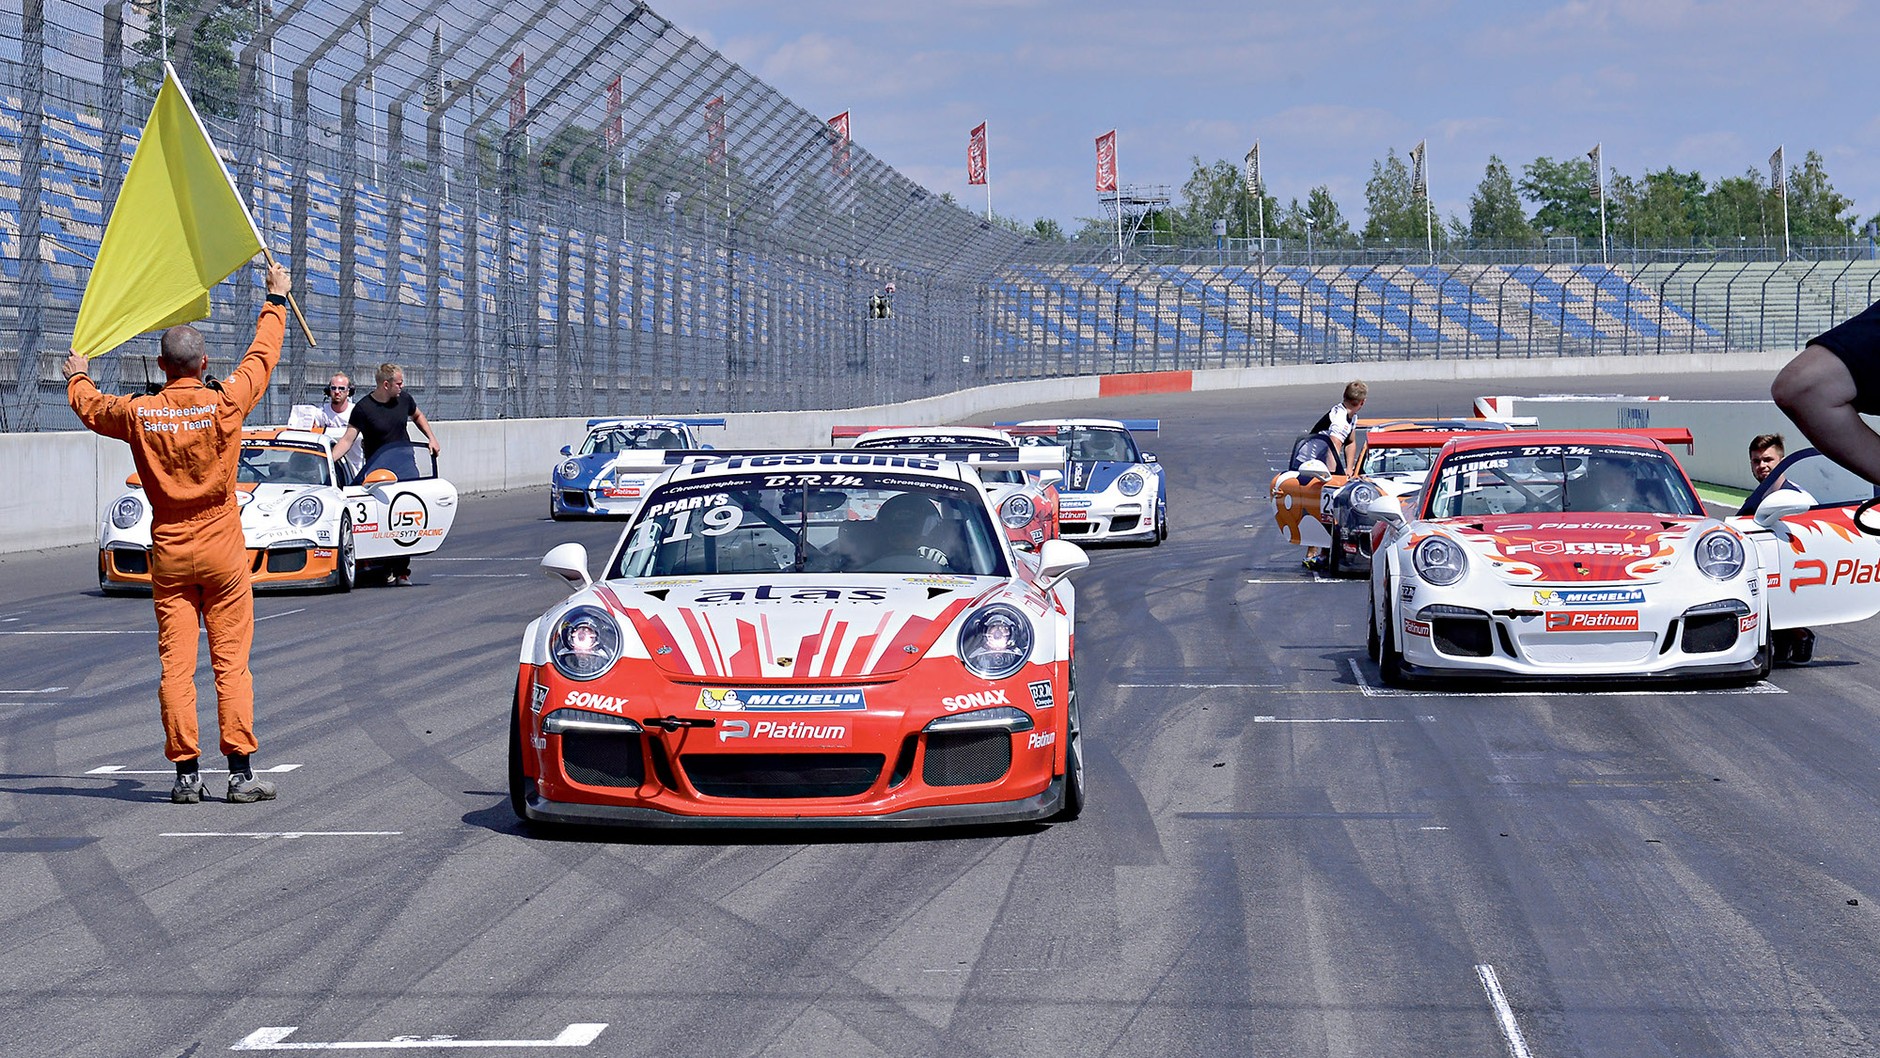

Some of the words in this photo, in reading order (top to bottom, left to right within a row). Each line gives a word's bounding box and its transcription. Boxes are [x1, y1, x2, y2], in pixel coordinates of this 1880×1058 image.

[137, 403, 217, 418] EuroSpeedway
[144, 421, 179, 434] Safety
[182, 419, 212, 431] Team
[1442, 459, 1508, 477] W.LUKAS
[763, 474, 865, 487] B.R.M
[1441, 471, 1482, 498] 11
[356, 502, 367, 523] 3
[649, 493, 729, 518] P.PARYS
[394, 511, 423, 527] JSR
[1060, 511, 1087, 519] atinum
[624, 504, 744, 552] 119
[1537, 523, 1652, 531] Platinum
[1566, 592, 1642, 601] MICHELIN
[1572, 613, 1637, 627] Platinum
[565, 691, 629, 713] SONAX
[747, 693, 861, 705] MICHELIN
[942, 690, 1011, 712] SONAX
[753, 721, 846, 739] Platinum
[1028, 732, 1056, 749] Platinum
